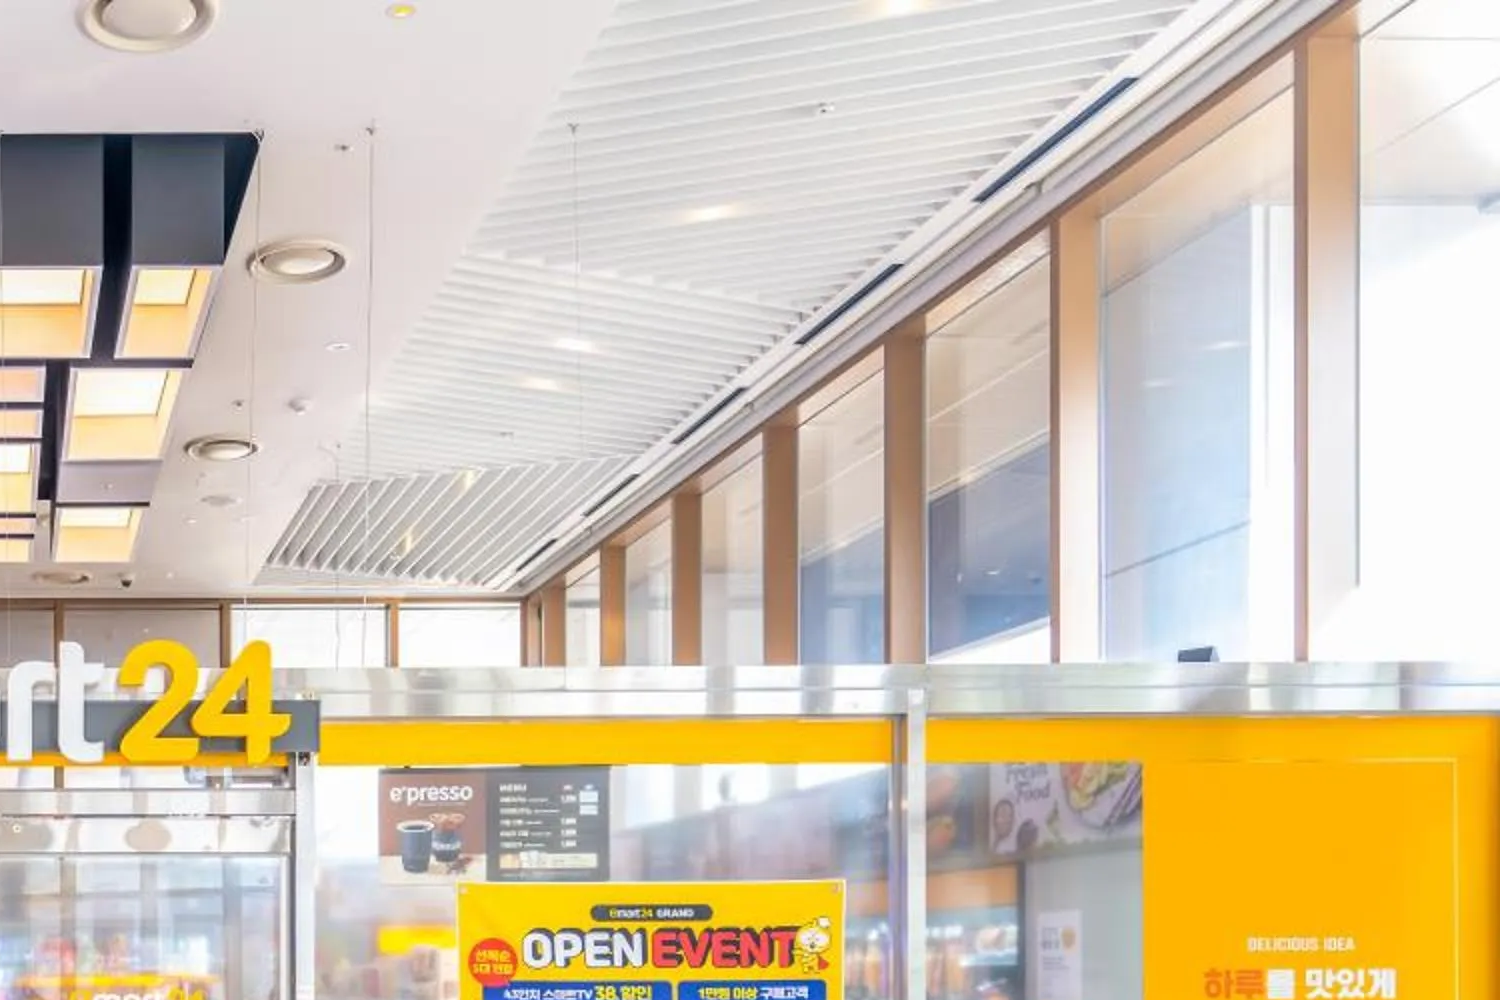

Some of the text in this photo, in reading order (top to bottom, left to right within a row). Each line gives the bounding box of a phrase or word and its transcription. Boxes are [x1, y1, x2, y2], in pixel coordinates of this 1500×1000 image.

[656, 908, 695, 919] GRAND
[522, 927, 799, 969] OPEN EVENT
[1247, 937, 1355, 952] DELICIOUS IDEA
[1204, 968, 1397, 1000] 하루를 맛있게
[733, 987, 757, 1000] 이상
